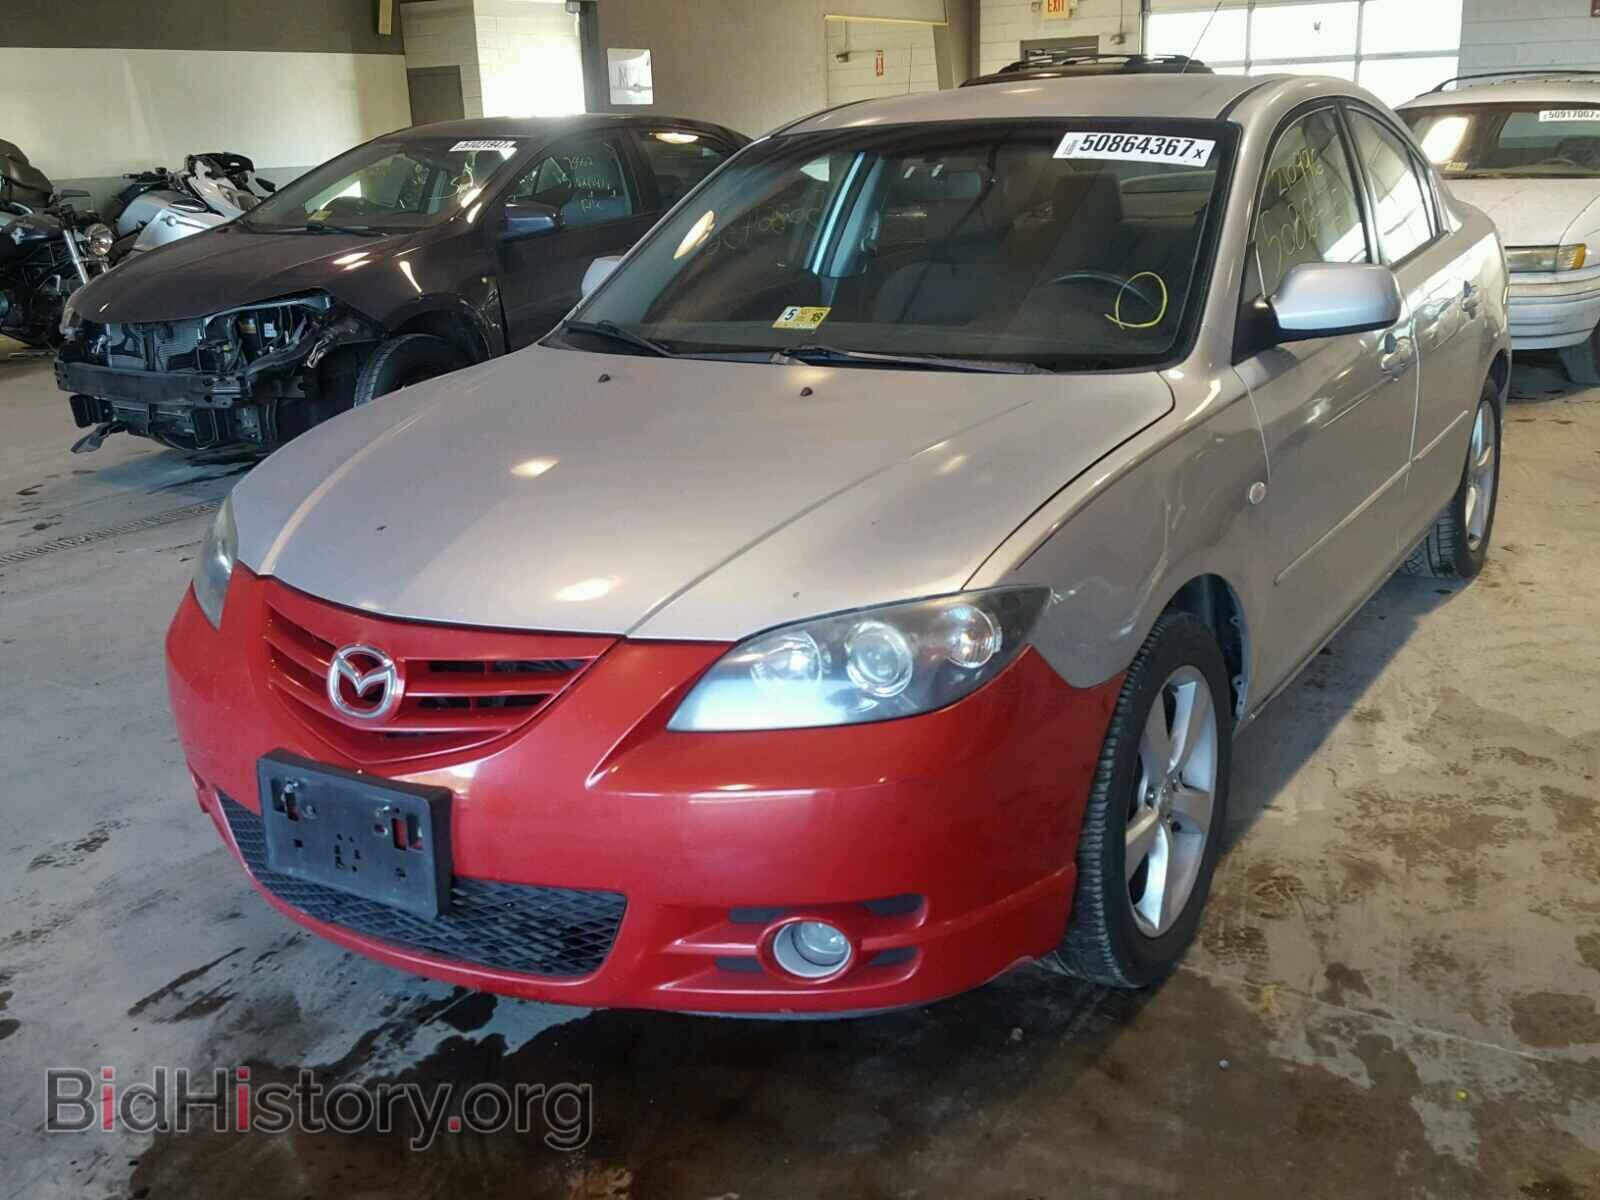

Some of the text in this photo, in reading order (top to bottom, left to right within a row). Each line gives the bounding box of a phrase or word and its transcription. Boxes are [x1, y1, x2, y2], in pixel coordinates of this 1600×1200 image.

[1047, 0, 1065, 13] EXIT
[1079, 134, 1195, 157] 50864367
[785, 308, 798, 321] 5
